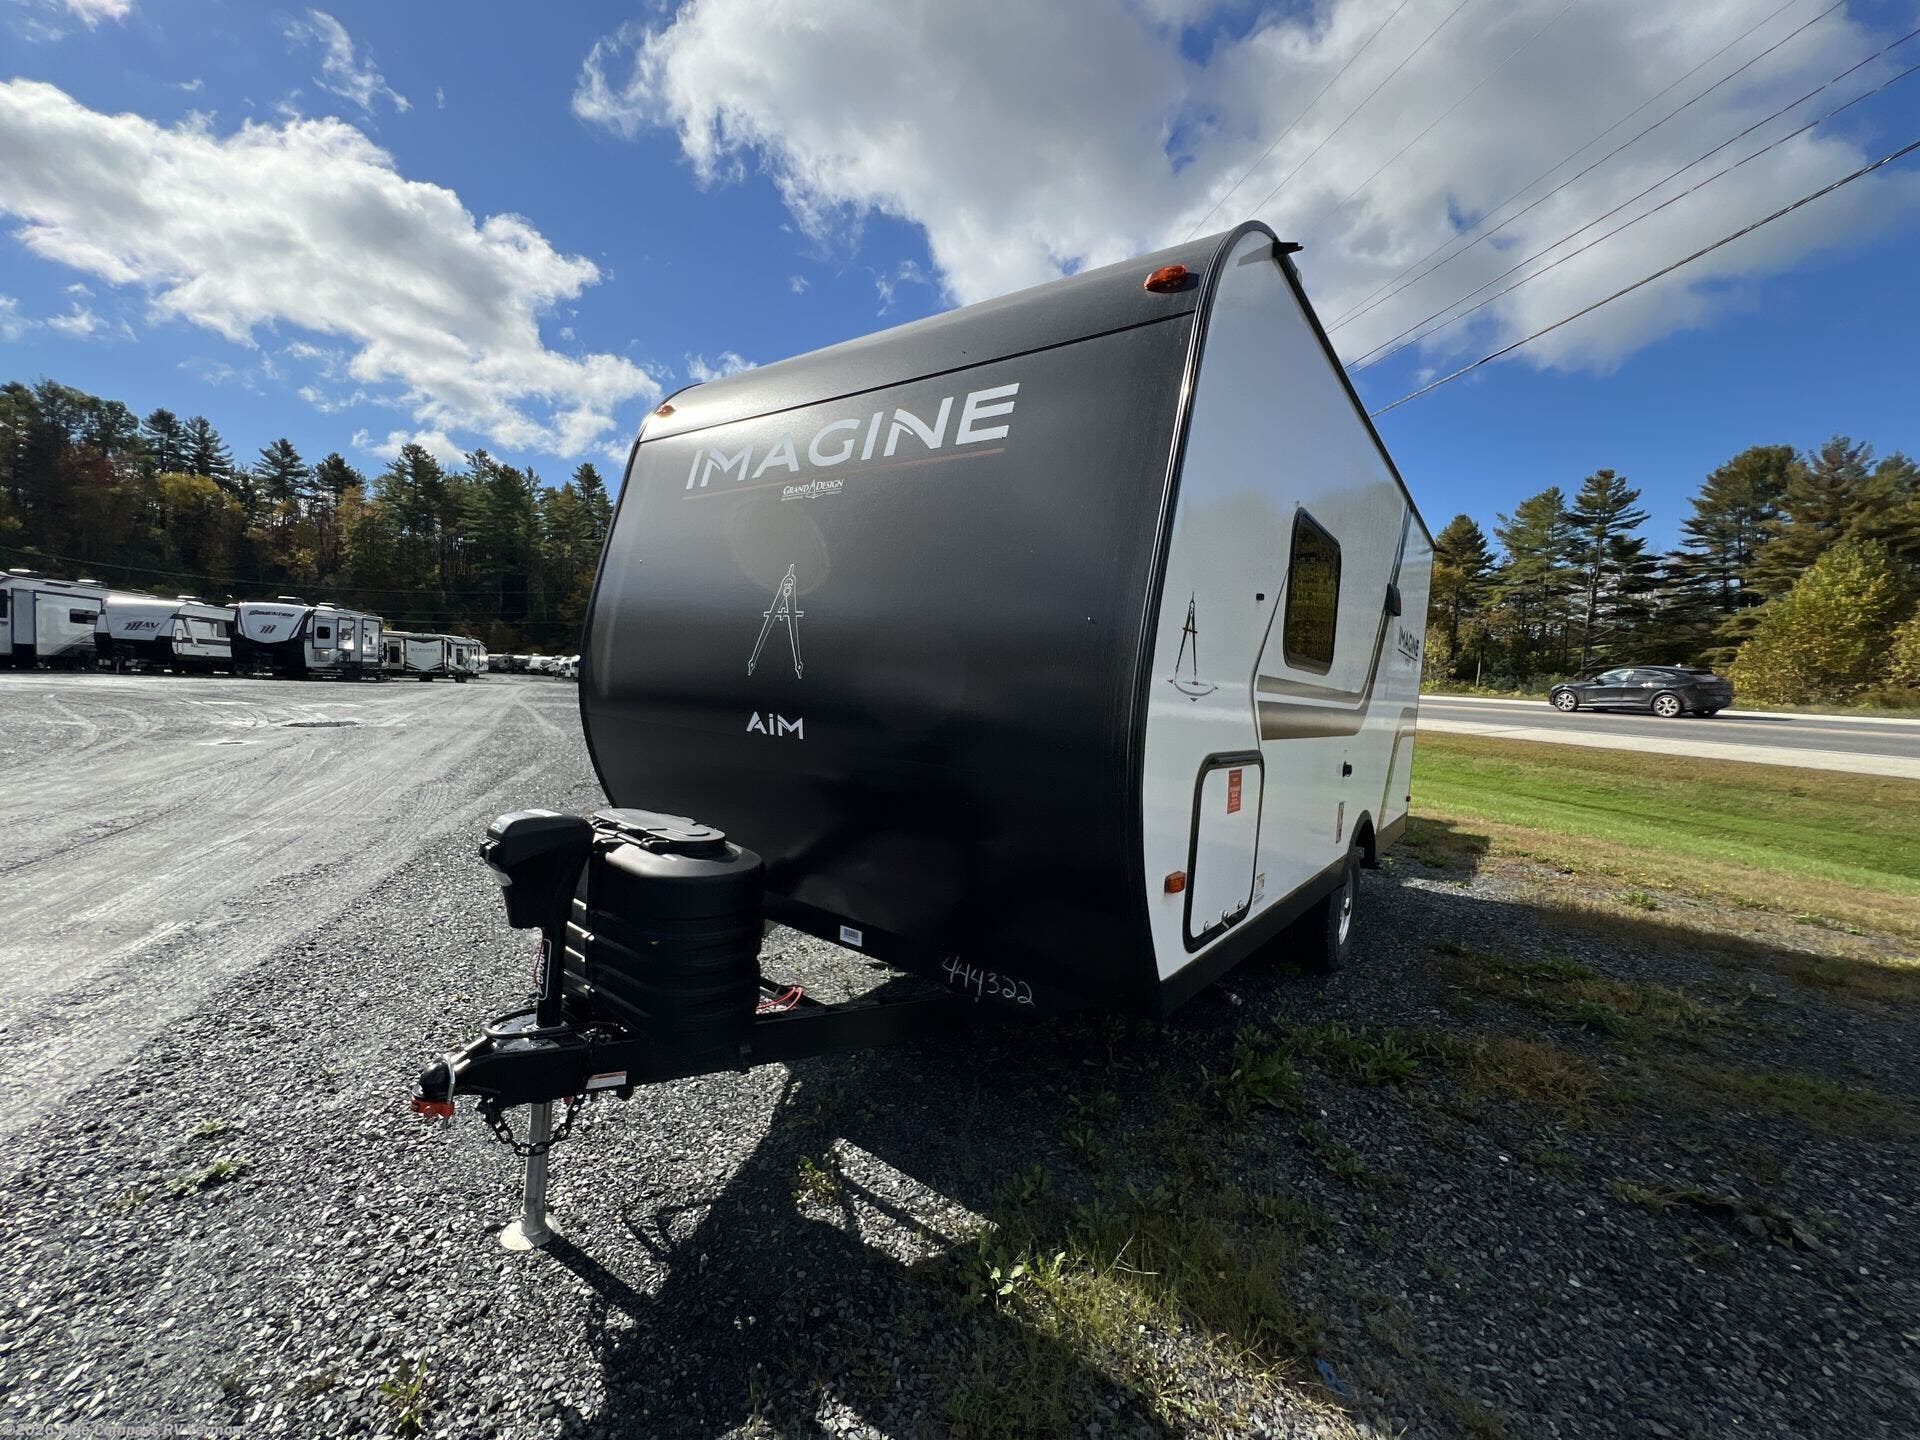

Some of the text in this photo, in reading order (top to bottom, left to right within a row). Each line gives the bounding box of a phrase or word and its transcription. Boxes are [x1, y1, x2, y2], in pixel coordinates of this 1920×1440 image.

[684, 382, 1020, 490] IMAGINE
[816, 479, 845, 491] DESIGN
[941, 955, 1036, 1006] 444322
